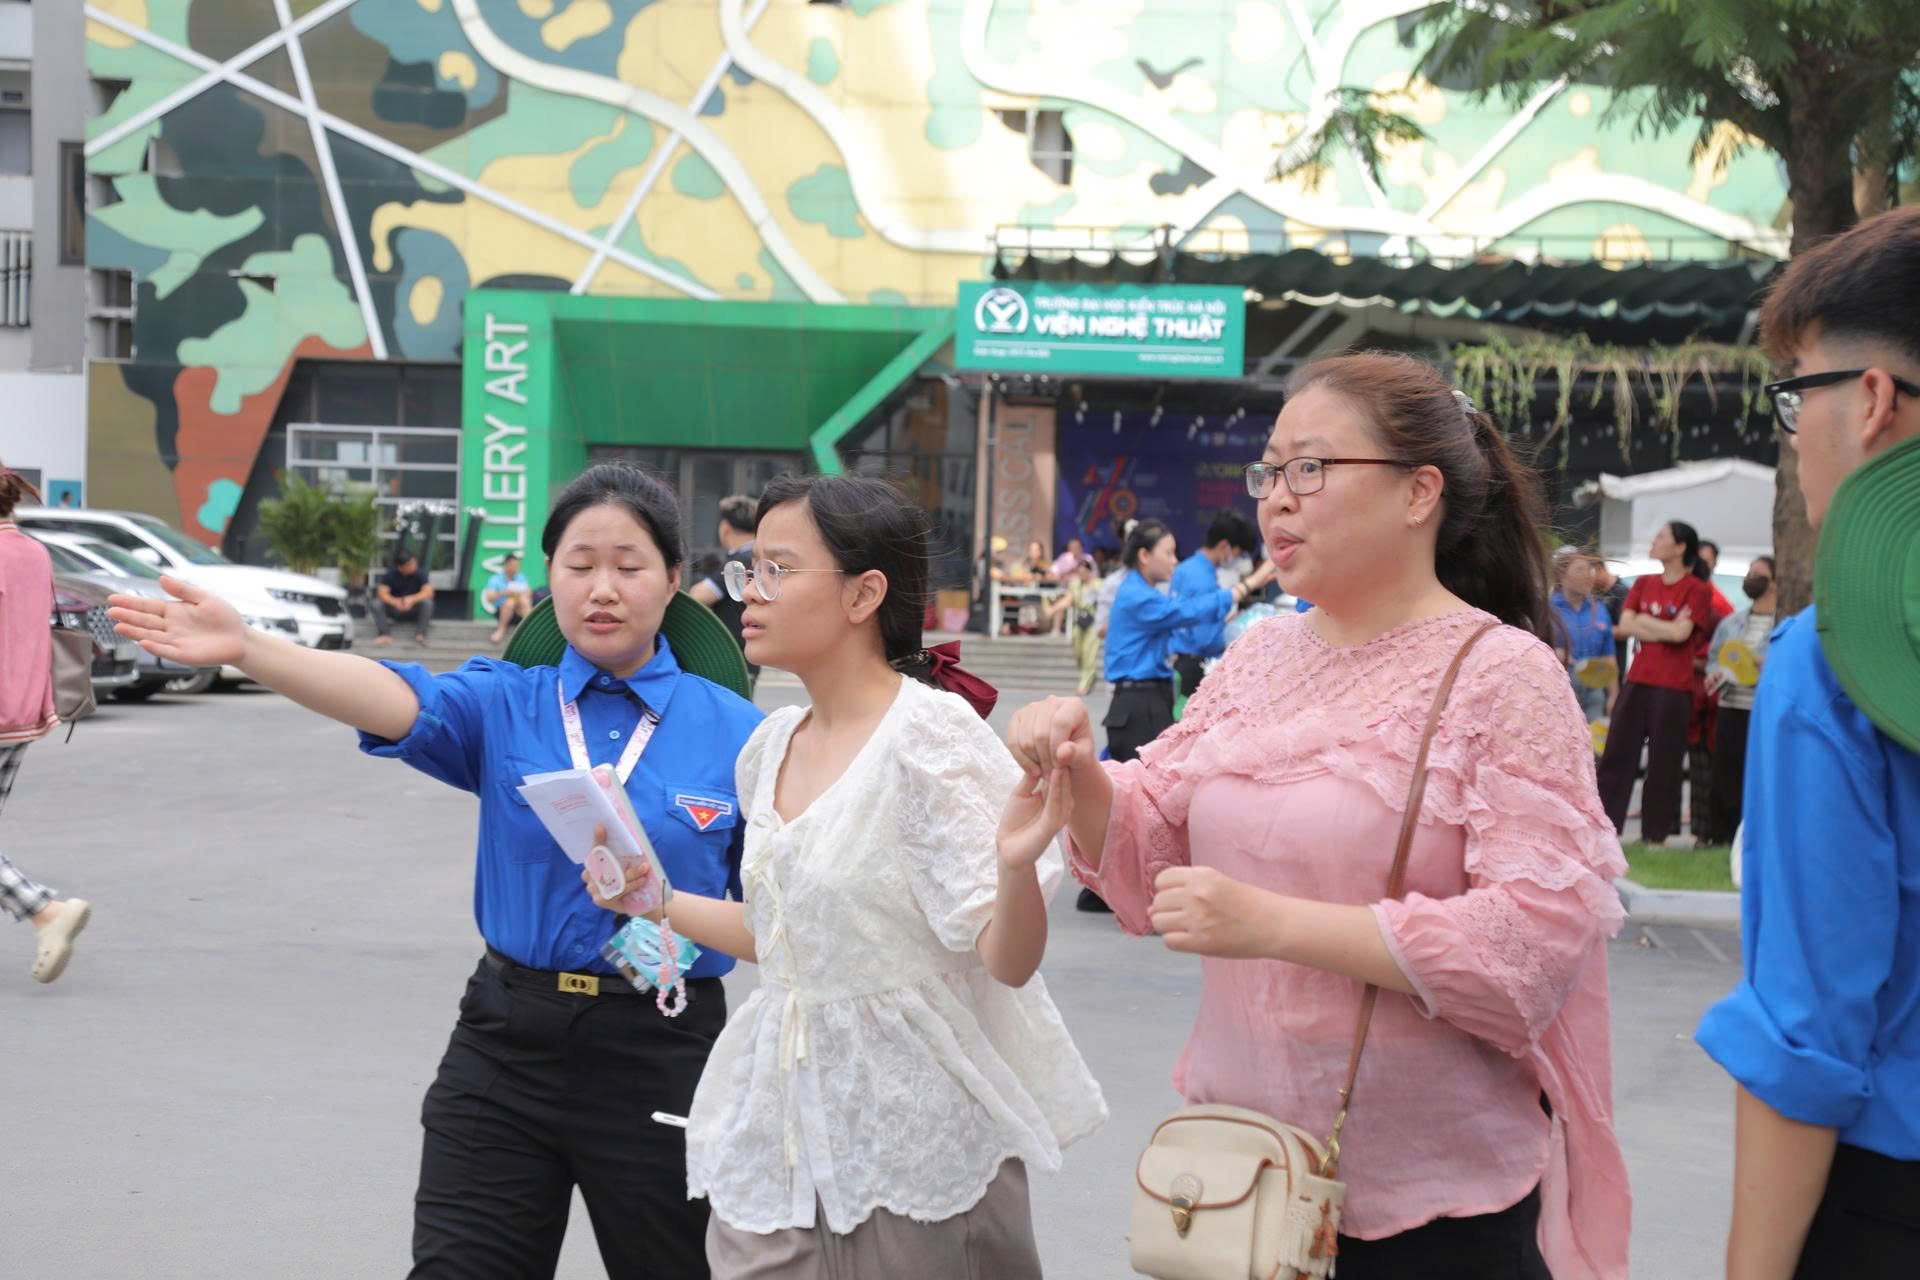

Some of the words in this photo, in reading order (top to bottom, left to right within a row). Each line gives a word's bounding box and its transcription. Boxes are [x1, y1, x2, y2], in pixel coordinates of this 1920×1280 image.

[1033, 310, 1085, 338] VIỆN
[1089, 313, 1149, 340] NGHỆ
[1154, 312, 1226, 342] THUẬT
[484, 313, 528, 404] ART
